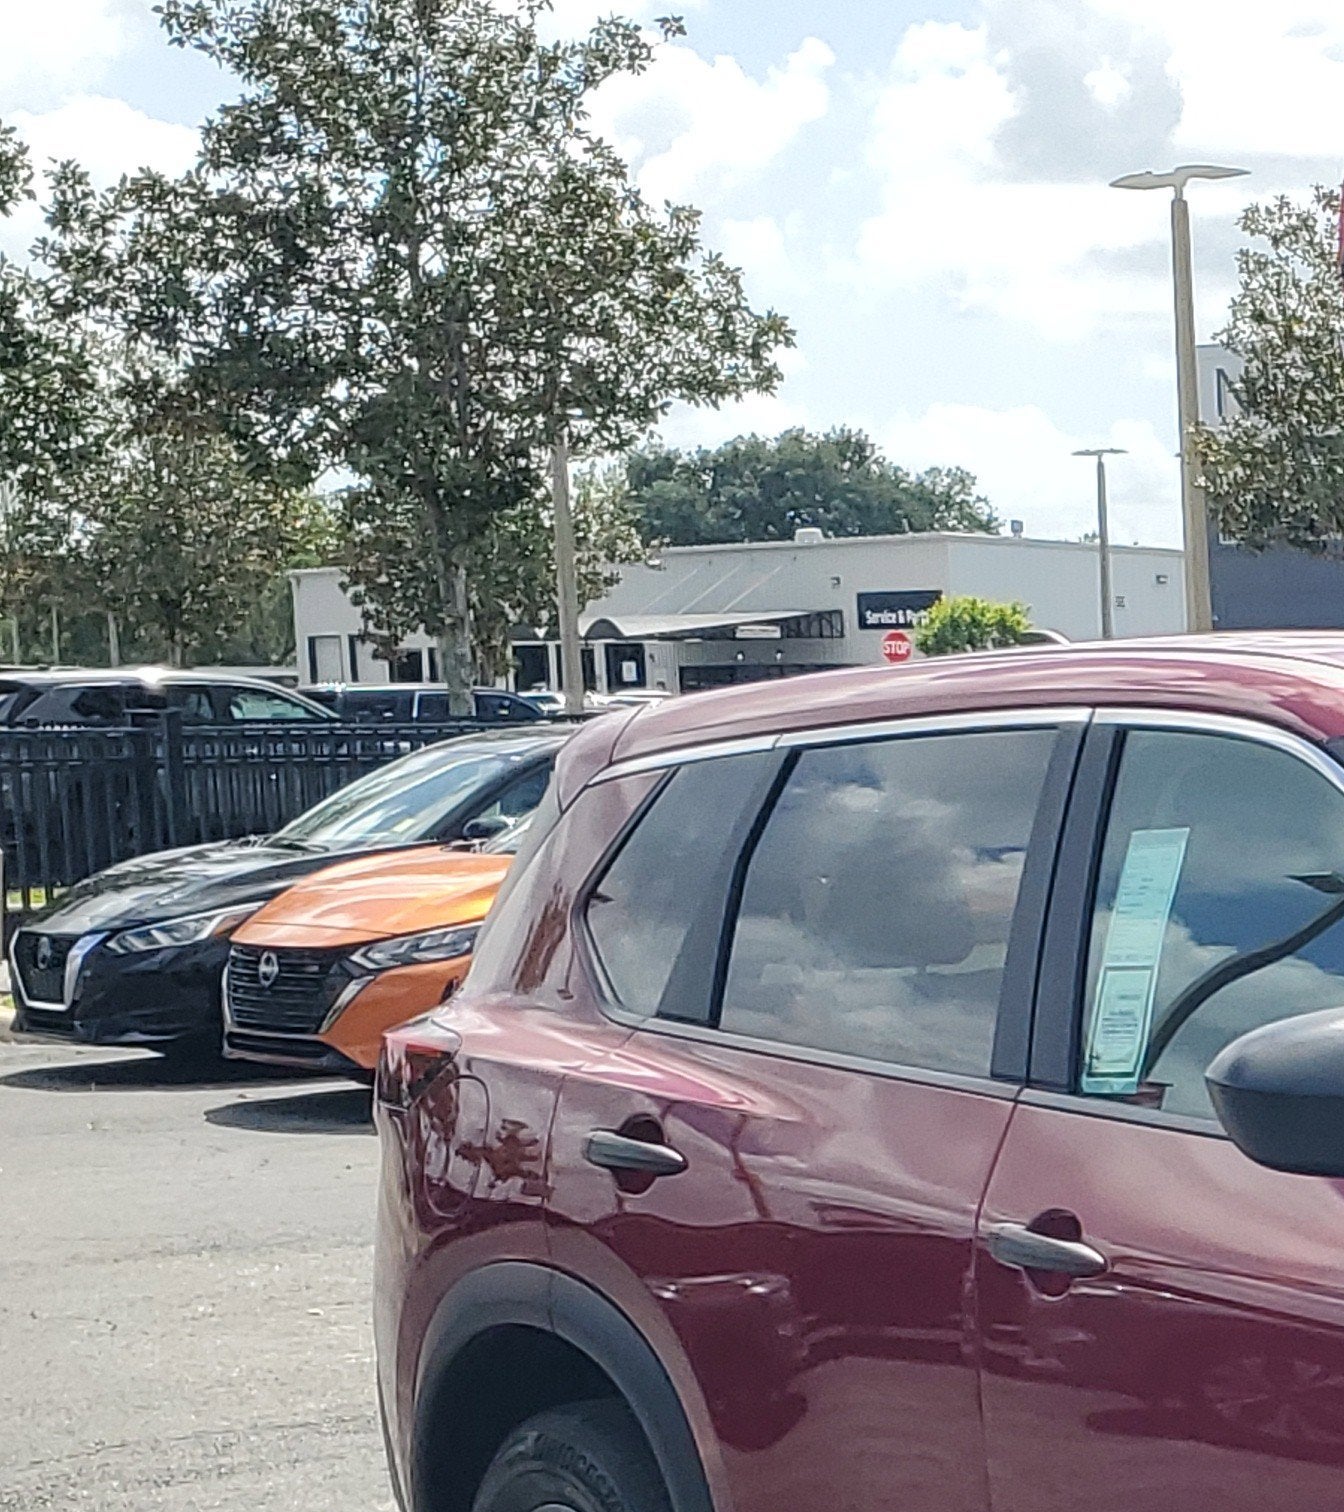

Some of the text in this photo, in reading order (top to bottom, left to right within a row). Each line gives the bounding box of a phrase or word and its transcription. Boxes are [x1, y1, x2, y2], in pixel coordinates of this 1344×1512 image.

[865, 609, 897, 625] Service
[898, 609, 906, 624] &
[883, 640, 911, 655] STOP
